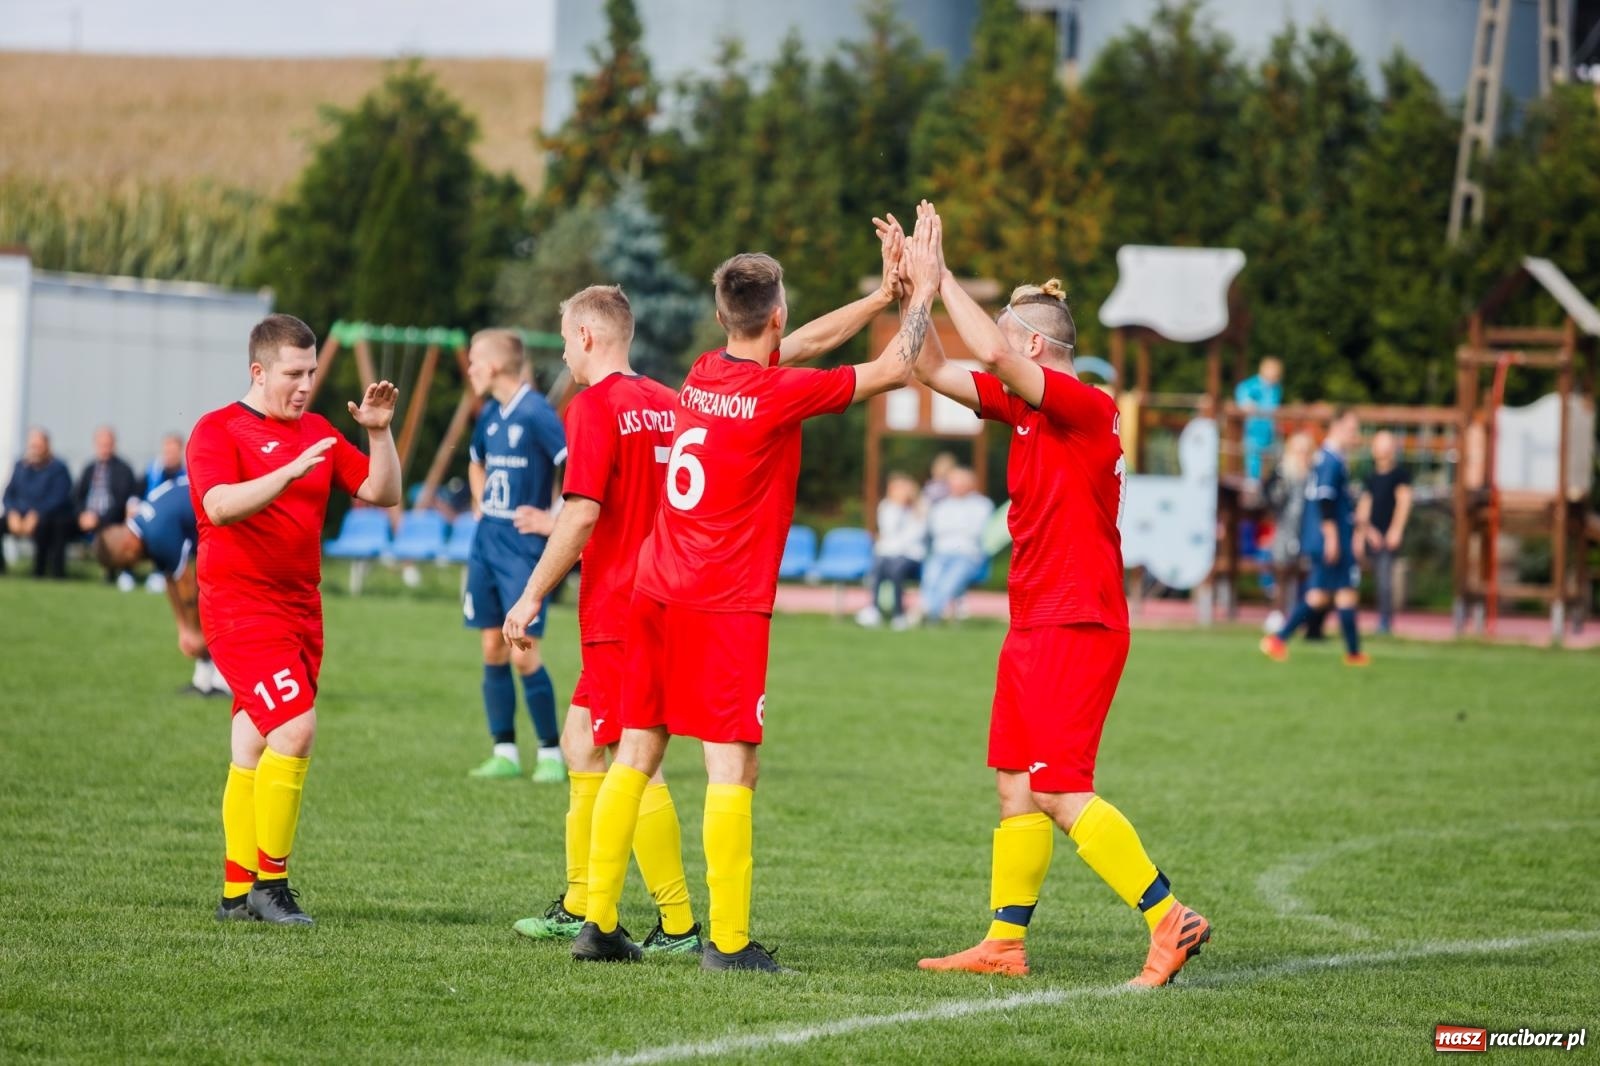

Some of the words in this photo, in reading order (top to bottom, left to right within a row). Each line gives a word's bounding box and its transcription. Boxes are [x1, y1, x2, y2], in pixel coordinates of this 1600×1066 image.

[681, 385, 758, 419] CYPRZANÓW
[618, 410, 642, 435] LKS
[666, 427, 708, 511] 6
[253, 668, 300, 711] 15
